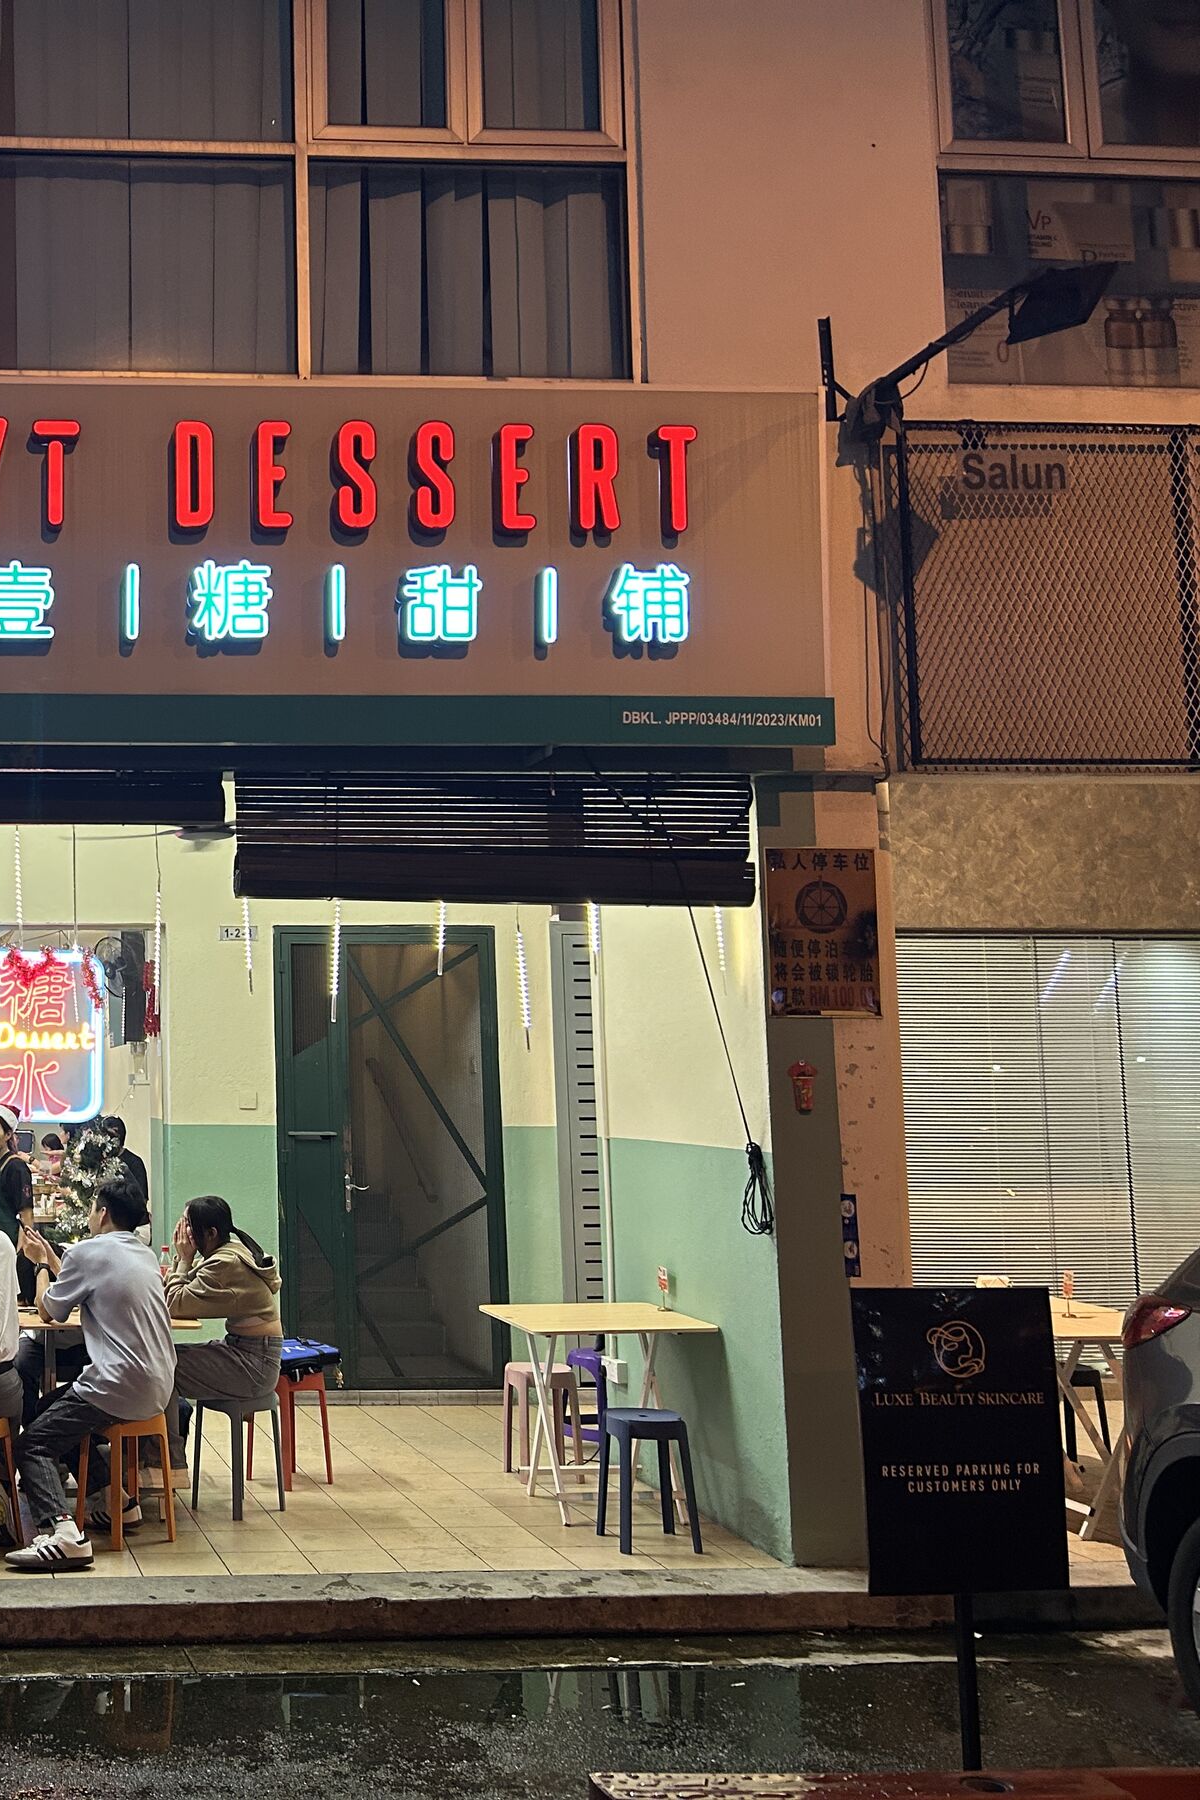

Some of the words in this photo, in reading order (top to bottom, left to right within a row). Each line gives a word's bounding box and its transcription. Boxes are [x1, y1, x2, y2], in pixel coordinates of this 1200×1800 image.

[173, 419, 698, 532] DESSERT
[962, 453, 1066, 490] Salun
[623, 711, 662, 725] DBKL.
[665, 712, 822, 727] JPPP/03484/11/2023/KM01
[875, 1392, 914, 1406] LUXE
[919, 1392, 976, 1406] BEAUTY
[977, 1391, 1045, 1405] SKINCARE
[882, 1465, 950, 1477] RESERVED
[956, 1463, 1011, 1476] PARKING
[1017, 1463, 1040, 1475] FOR
[907, 1480, 986, 1493] CUSTOMERS
[991, 1479, 1022, 1492] ONLY
